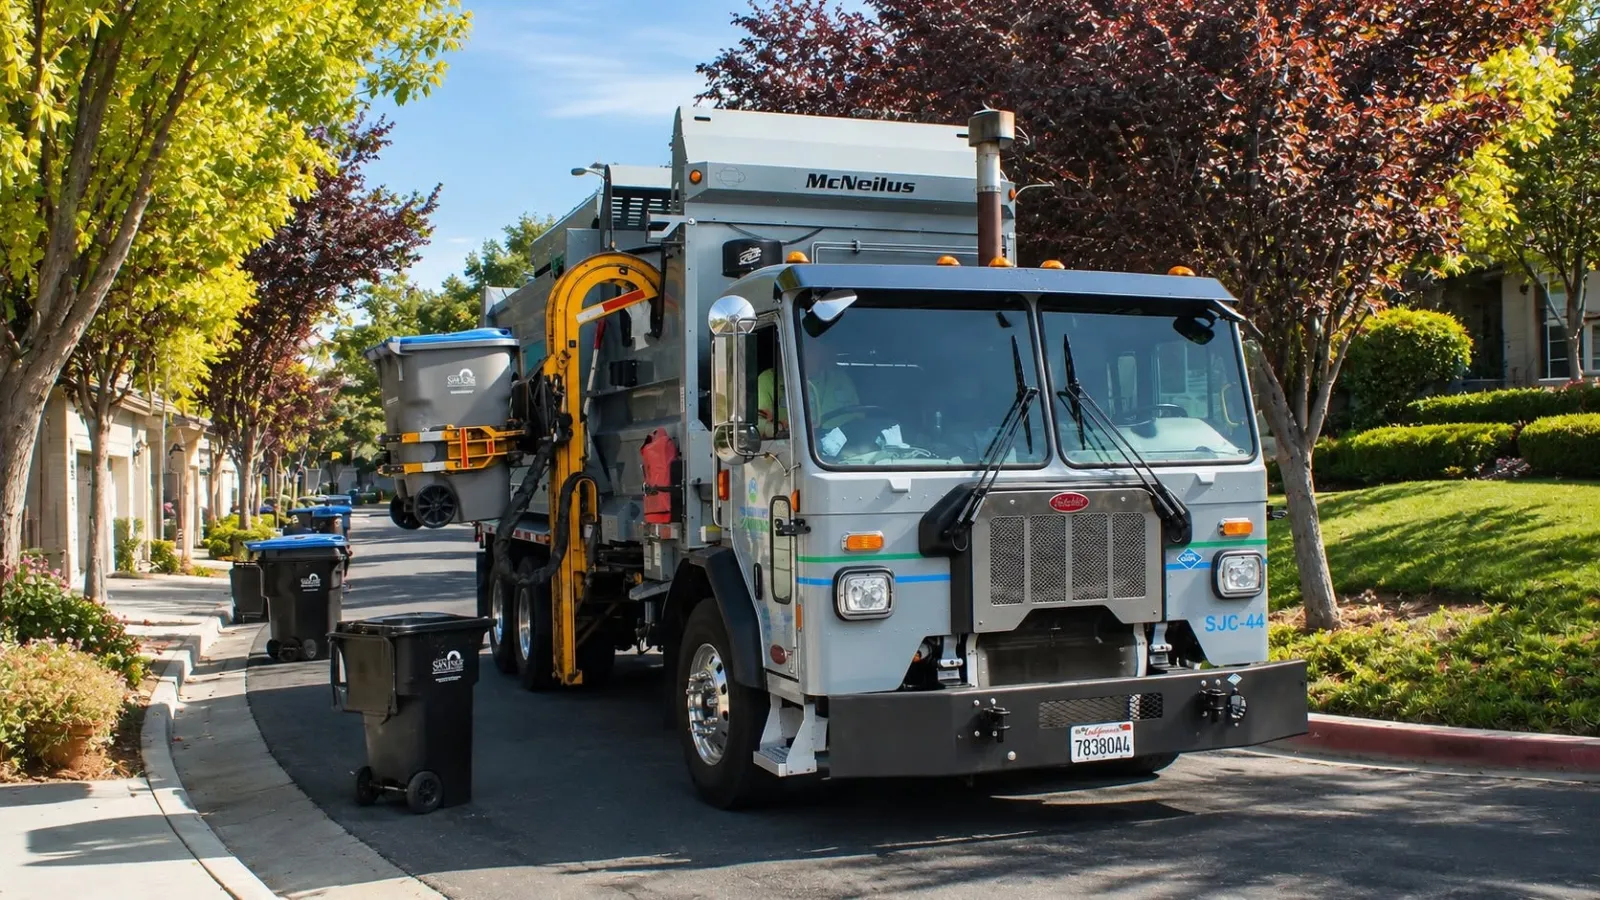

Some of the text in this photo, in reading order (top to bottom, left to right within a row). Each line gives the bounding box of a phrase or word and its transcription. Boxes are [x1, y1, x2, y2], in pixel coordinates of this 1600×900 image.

[806, 173, 916, 193] McNeilus
[1205, 613, 1265, 632] SJC-44
[1075, 736, 1131, 757] 78380A4
